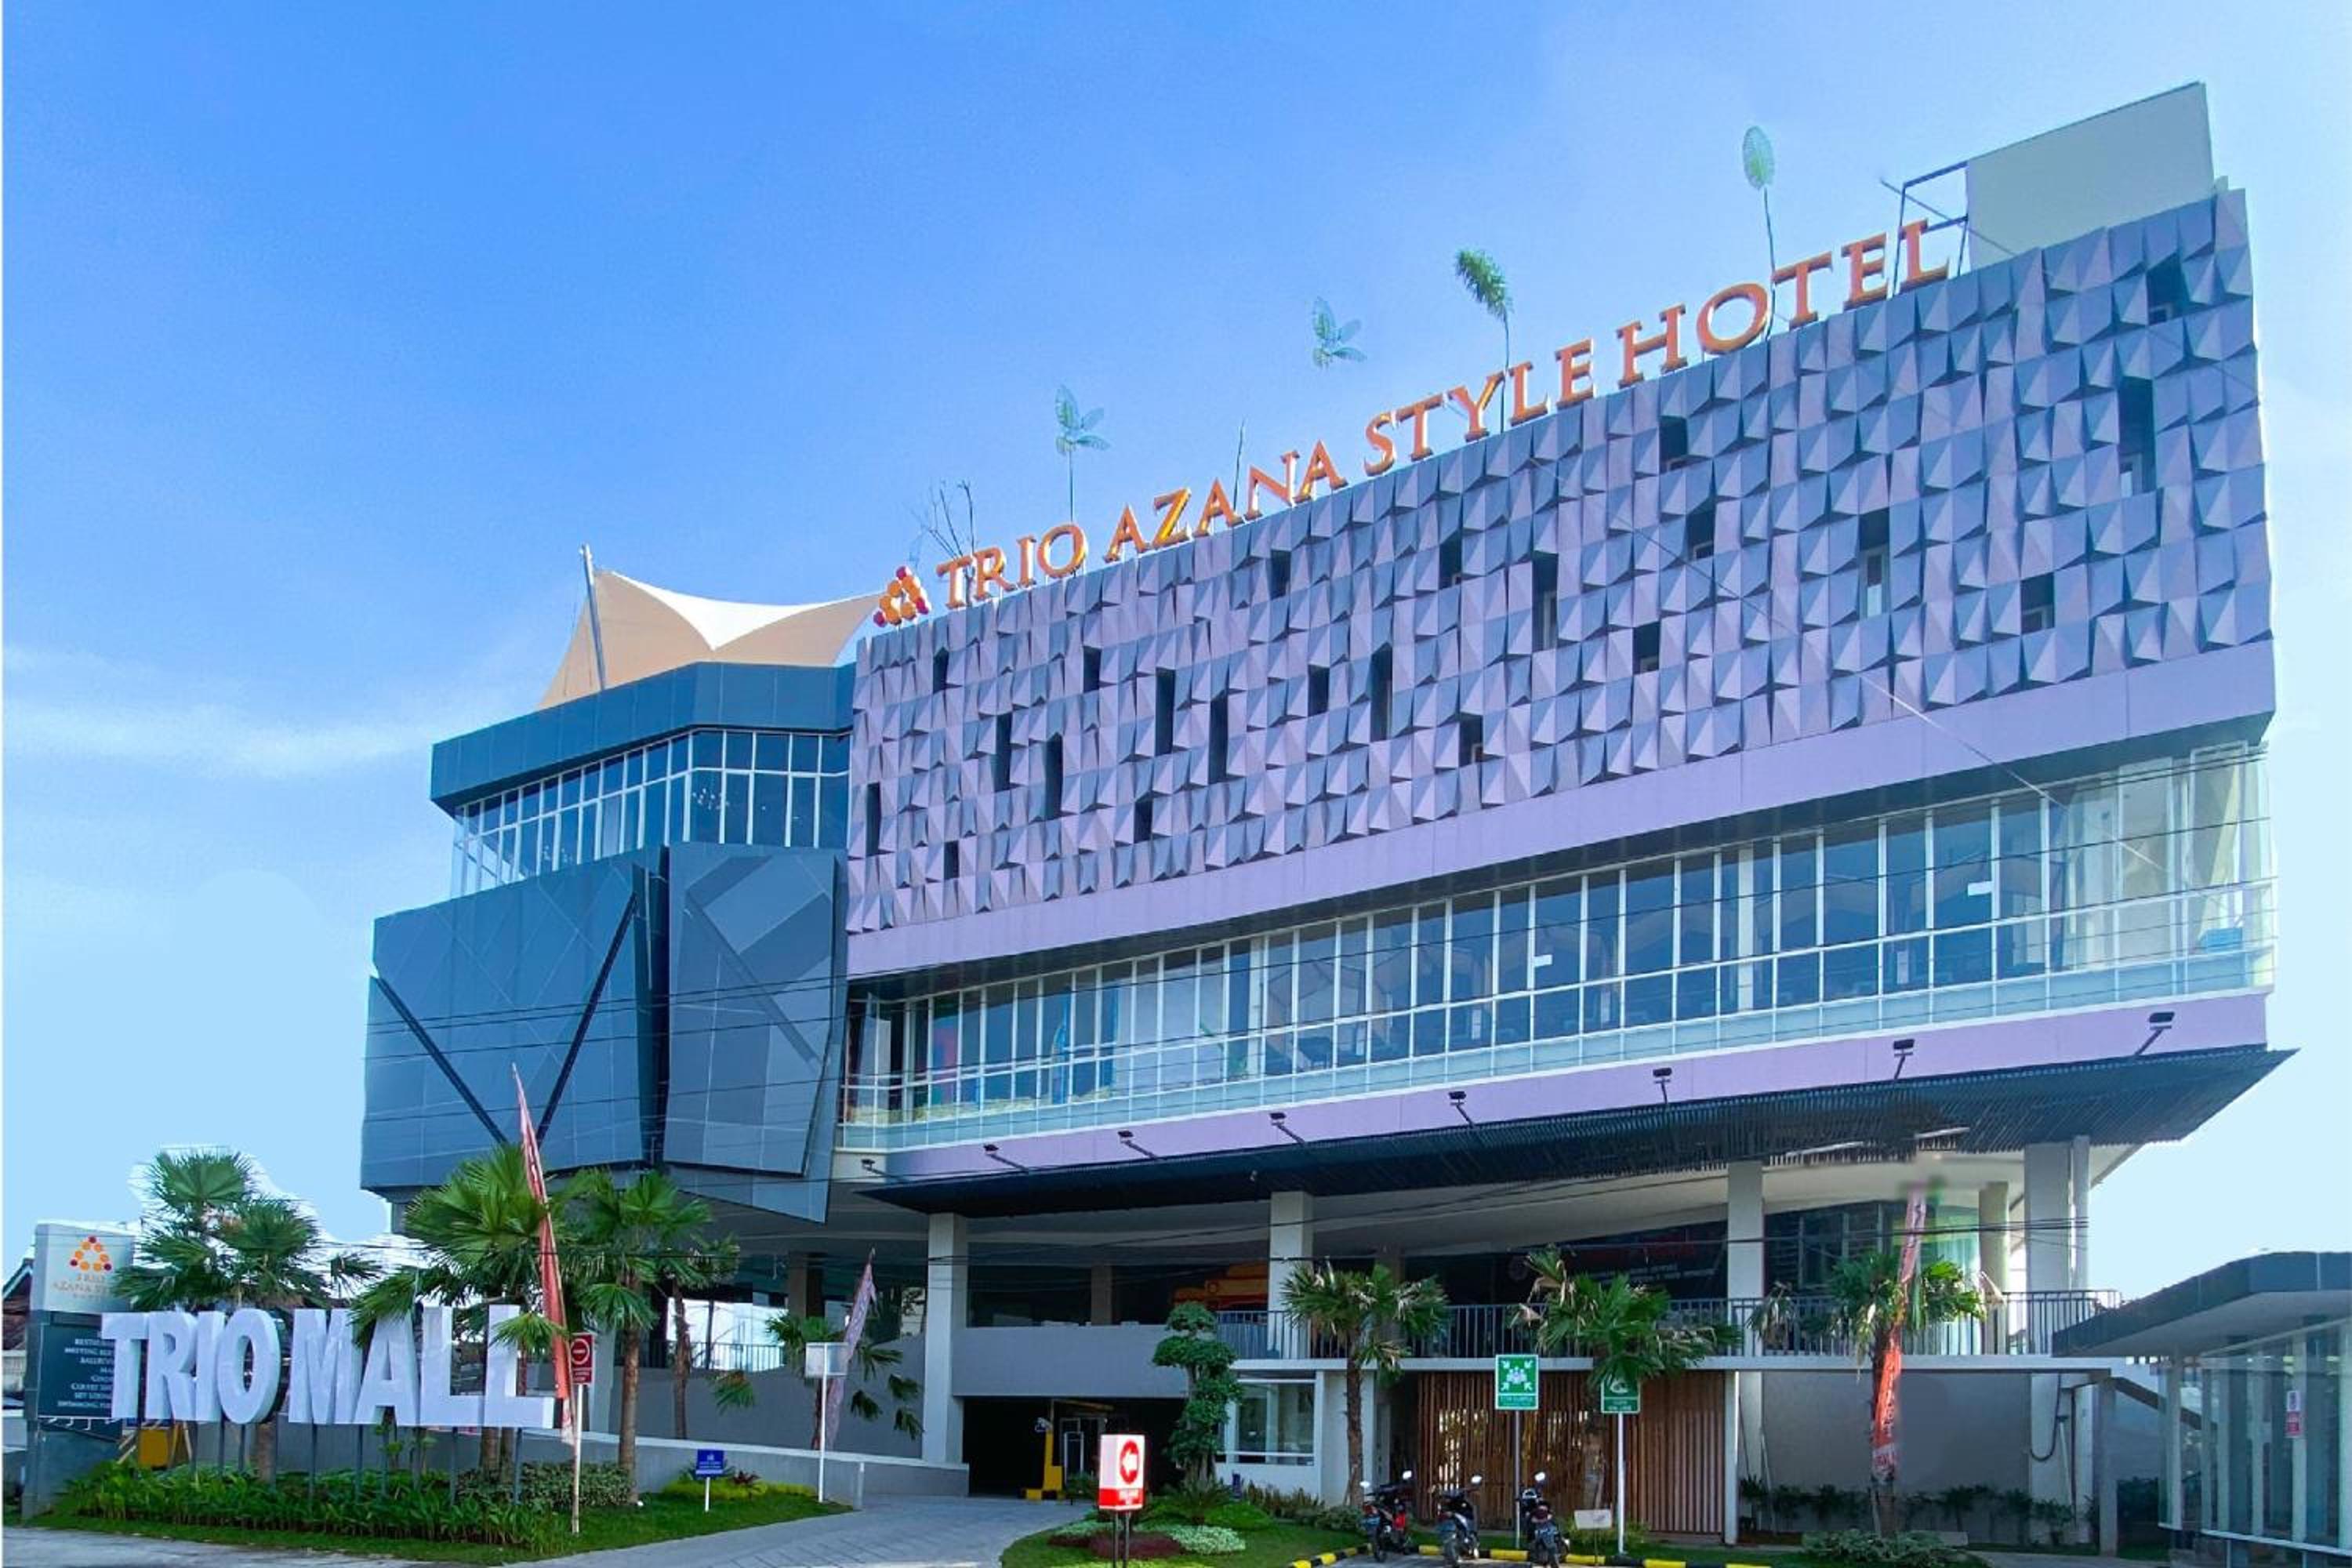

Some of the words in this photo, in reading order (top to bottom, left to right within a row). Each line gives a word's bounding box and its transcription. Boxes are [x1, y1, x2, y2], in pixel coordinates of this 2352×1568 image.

[937, 523, 1088, 610] TRIO
[1104, 439, 1348, 563] AZANA
[1364, 338, 1595, 477] STYLE
[1617, 219, 1951, 389] HOTEL
[100, 1308, 281, 1425] TRIO
[288, 1303, 554, 1429] MALL
